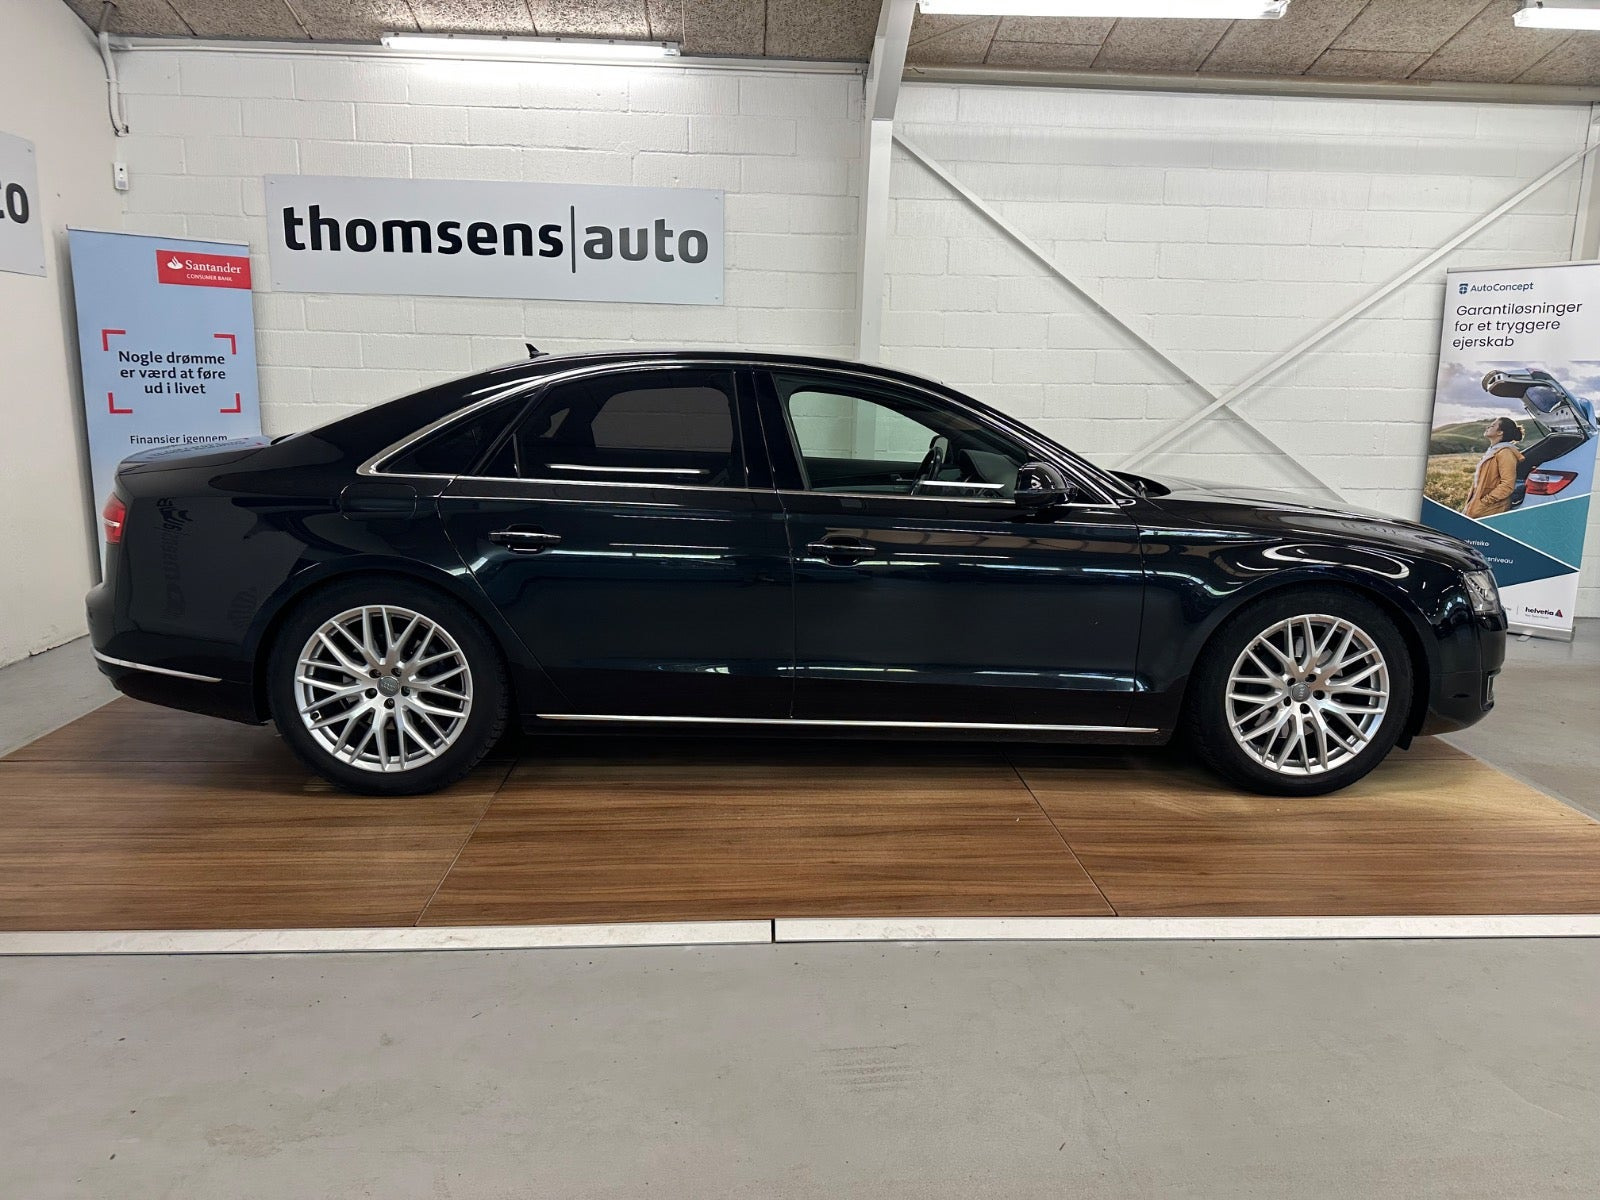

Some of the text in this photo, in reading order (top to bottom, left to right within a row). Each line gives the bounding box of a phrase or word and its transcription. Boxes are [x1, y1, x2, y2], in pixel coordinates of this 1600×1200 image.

[0, 181, 29, 224] o
[185, 259, 242, 274] Santander
[1470, 281, 1534, 292] AutoConcept
[1456, 302, 1583, 316] Garantiløsninger
[1454, 320, 1561, 334] for et tryggere
[1452, 336, 1515, 350] ejerskab
[118, 350, 225, 366] Nogle drømme
[119, 367, 226, 380] er værd at føre
[144, 381, 207, 394] ud i livet
[130, 434, 228, 444] Finansier igennem
[1525, 606, 1554, 616] helvetia
